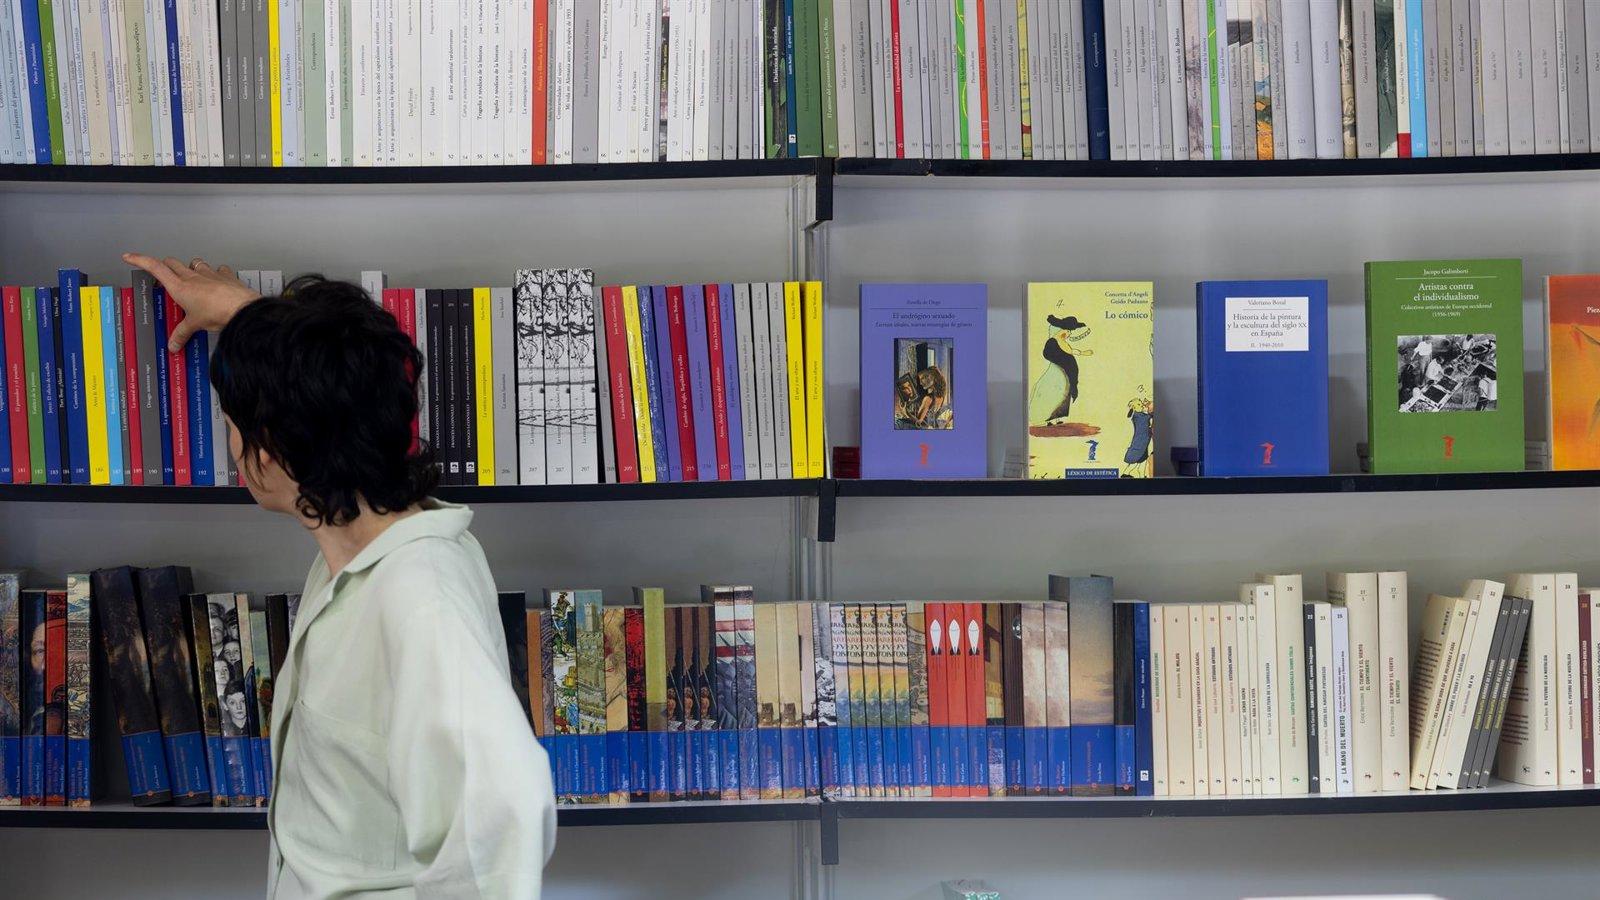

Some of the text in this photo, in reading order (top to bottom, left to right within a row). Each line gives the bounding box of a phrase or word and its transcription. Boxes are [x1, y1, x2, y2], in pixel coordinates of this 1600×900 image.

[136, 74, 144, 91] Kraus,
[1441, 267, 1469, 275] Galimberti
[1418, 282, 1448, 291] Artistas
[1413, 292, 1479, 302] el individualismo
[1105, 310, 1148, 319] Lo cómico
[1233, 313, 1301, 322] Historia de la pintura
[1233, 321, 1239, 329] la
[1240, 321, 1269, 329] escultura
[1270, 321, 1281, 329] del
[1282, 321, 1297, 330] siglo
[1260, 329, 1284, 338] España
